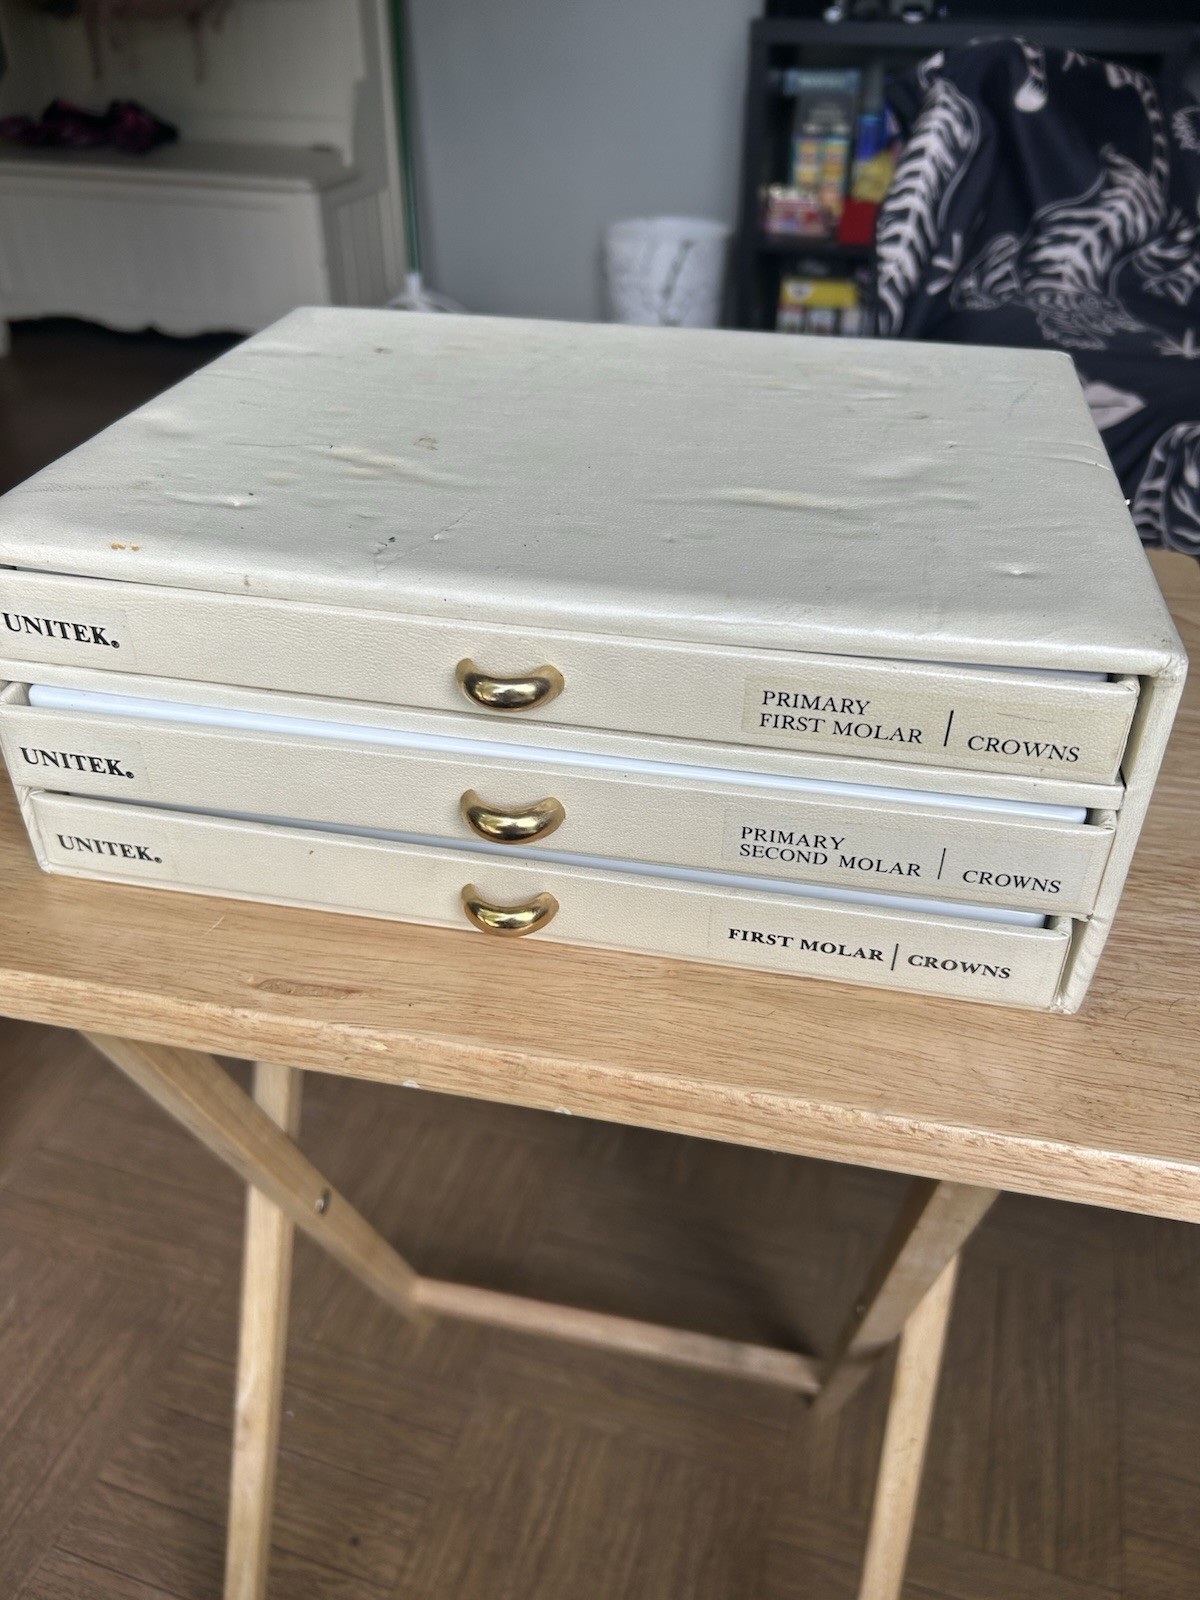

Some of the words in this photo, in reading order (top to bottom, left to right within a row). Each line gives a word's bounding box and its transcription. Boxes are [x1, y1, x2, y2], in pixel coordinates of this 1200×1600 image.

[762, 690, 870, 716] PRIMARY
[759, 713, 825, 733] FIRST
[833, 720, 923, 744] MOLAR
[967, 735, 1080, 763] CROWNS
[741, 826, 845, 850] PRIMARY
[739, 844, 828, 866] SECOND
[839, 855, 921, 877] MOLAR
[962, 869, 1061, 894] CROWNS
[728, 928, 794, 948] FIRST
[800, 939, 884, 962] MOLAR
[907, 954, 1011, 979] CROWNS
